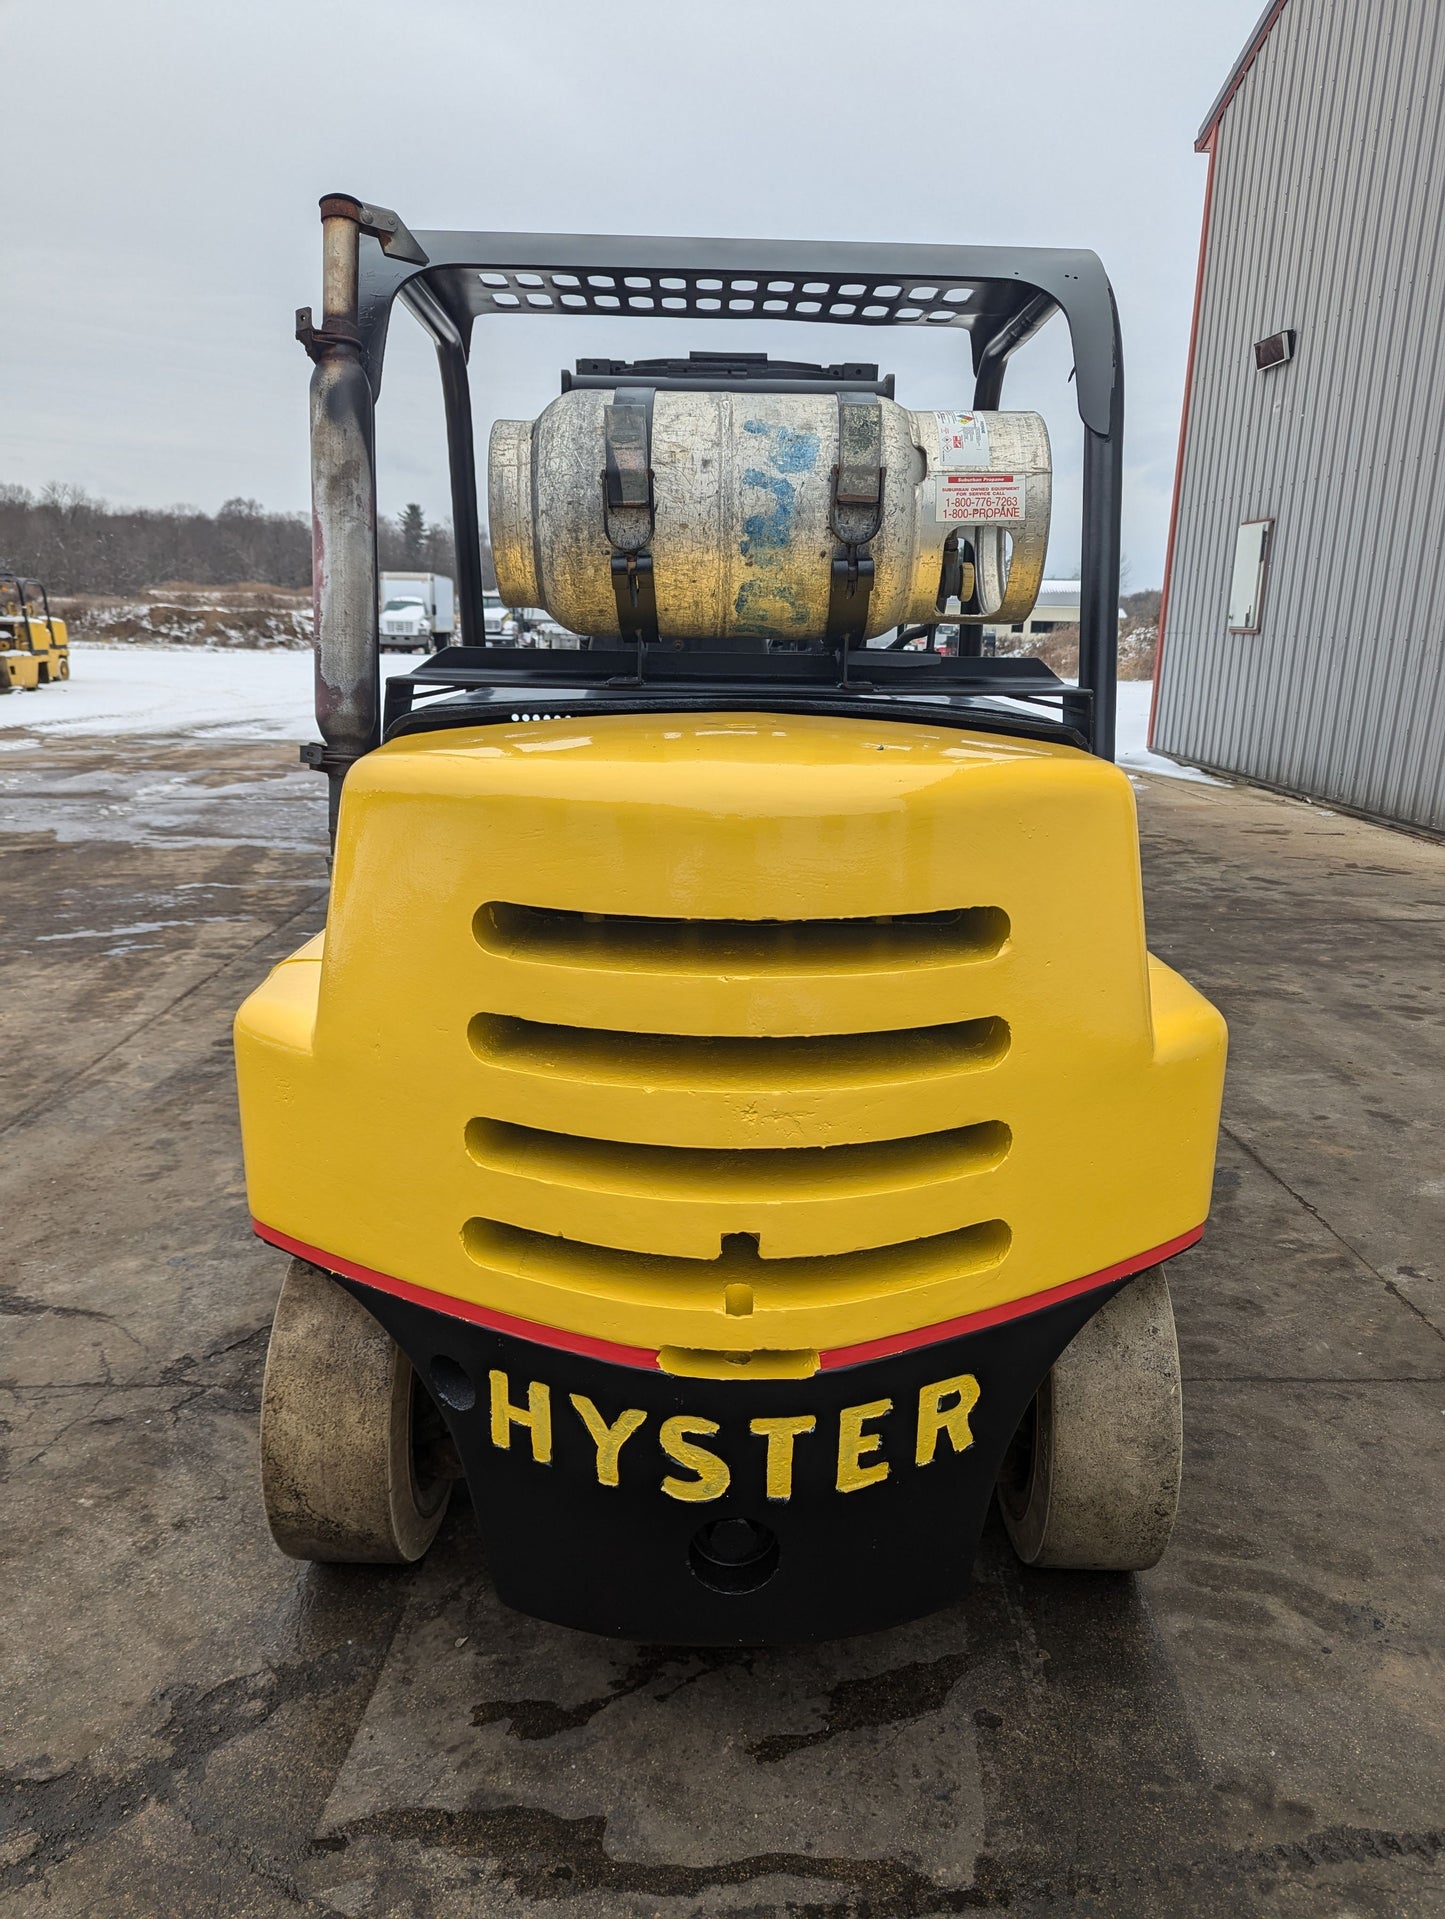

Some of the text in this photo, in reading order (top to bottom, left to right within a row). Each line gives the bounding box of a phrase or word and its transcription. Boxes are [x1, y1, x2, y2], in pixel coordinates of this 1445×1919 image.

[946, 497, 1018, 507] 1-800-776-7263
[943, 507, 1020, 518] 1-800-PROPANE
[489, 1370, 981, 1503] HYSTER
